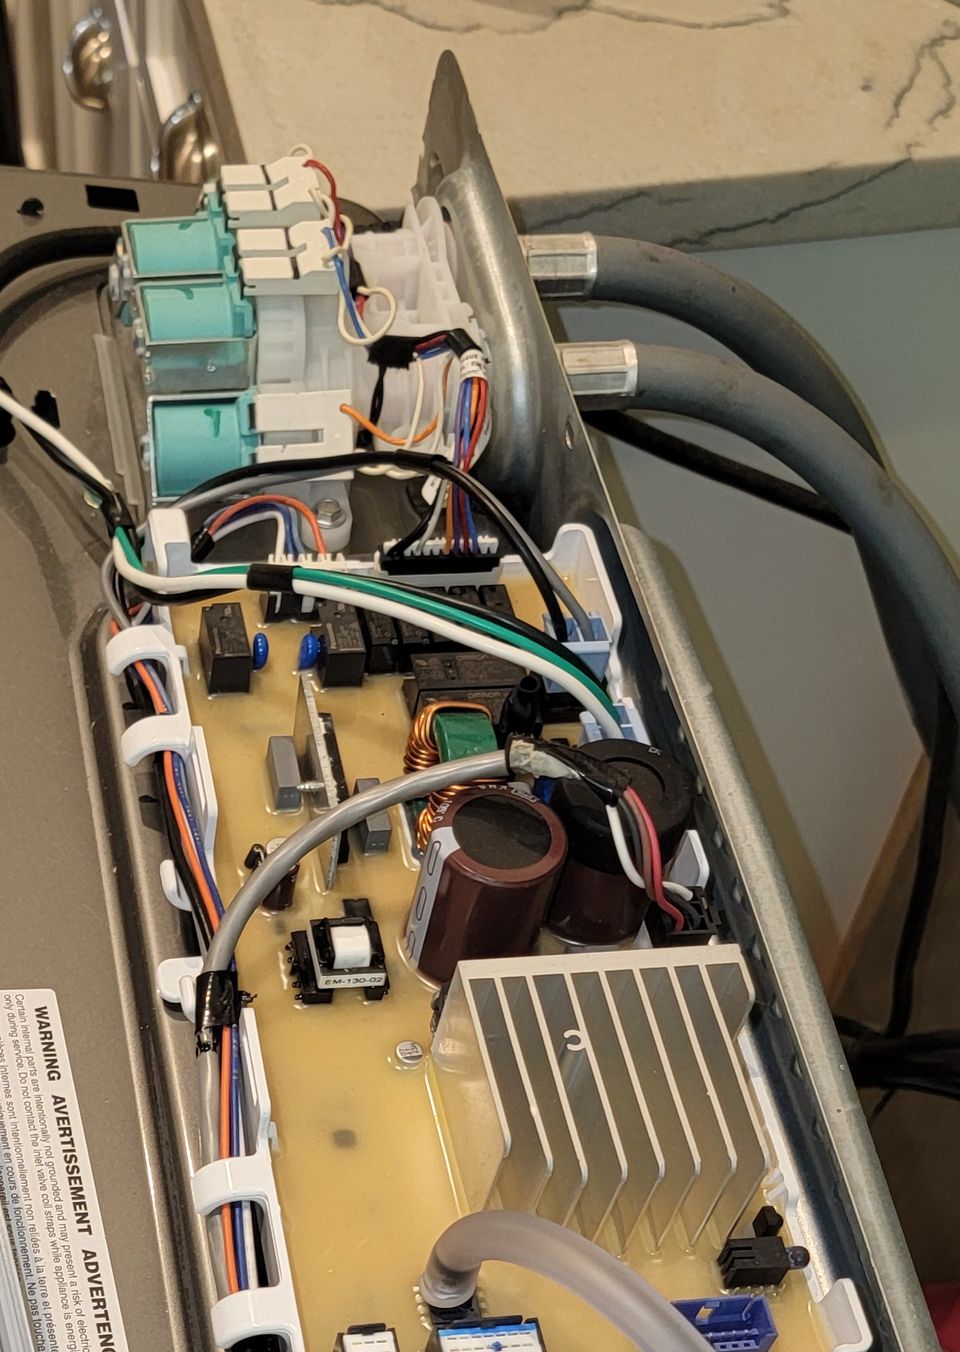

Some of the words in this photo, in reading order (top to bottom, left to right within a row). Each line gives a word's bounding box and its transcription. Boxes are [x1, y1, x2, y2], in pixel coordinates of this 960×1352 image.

[324, 977, 383, 985] EM-130-02
[3, 994, 14, 1010] only
[14, 993, 28, 1023] Certain
[6, 1012, 18, 1037] during
[20, 1024, 35, 1054] internal
[11, 1039, 25, 1070] service.
[23, 1055, 37, 1077] parts
[20, 1086, 32, 1100] not
[30, 1078, 40, 1092] are
[23, 1101, 37, 1131] contact
[33, 1094, 51, 1143] intentionally
[34, 1006, 61, 1081] WARNING
[51, 1094, 93, 1236] AVERTISSEMENT
[29, 1133, 39, 1147] the
[32, 1148, 44, 1167] inlet
[43, 1145, 55, 1159] not
[36, 1168, 48, 1191] valve
[44, 1160, 63, 1202] grounded
[41, 1193, 53, 1208] coil
[44, 1210, 56, 1238] straps
[54, 1204, 67, 1221] and
[58, 1223, 69, 1242] may
[49, 1239, 62, 1263] while
[60, 1244, 76, 1279] present
[52, 1265, 69, 1309] appliance
[70, 1289, 83, 1306] risk
